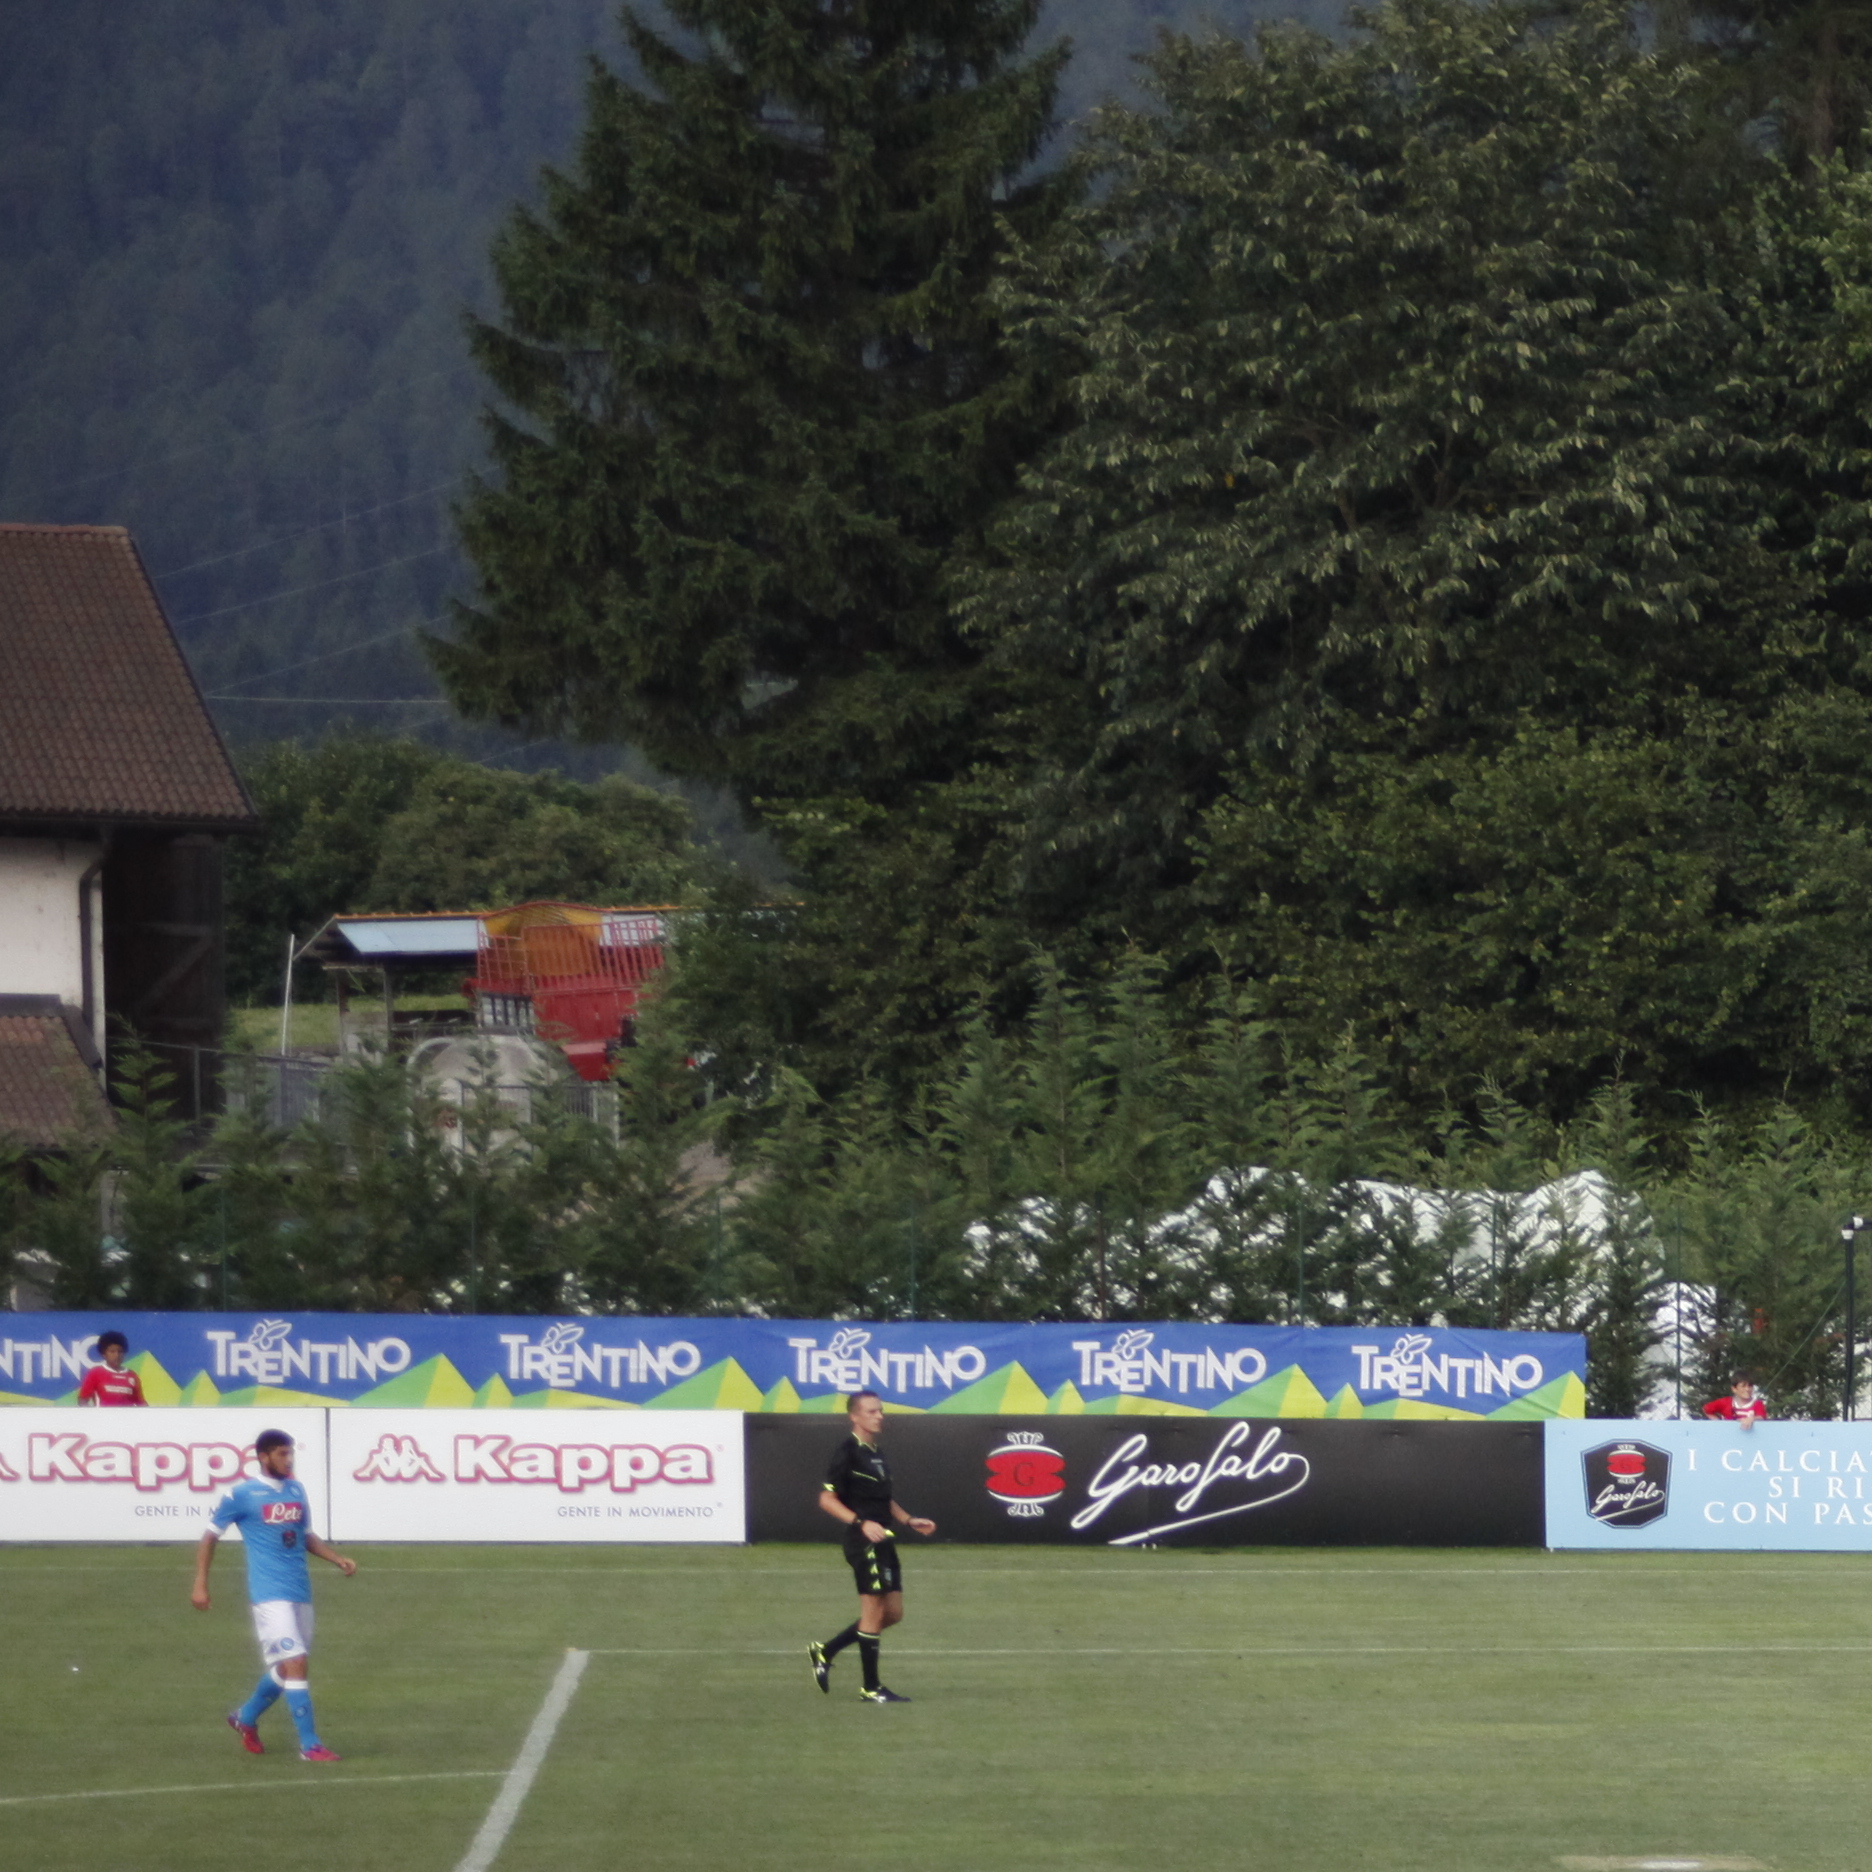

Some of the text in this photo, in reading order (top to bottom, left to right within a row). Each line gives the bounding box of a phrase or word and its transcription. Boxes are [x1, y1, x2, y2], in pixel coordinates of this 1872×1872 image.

[206, 1331, 411, 1385] TRENTINO
[500, 1334, 702, 1388] TRENTINO
[788, 1338, 987, 1393] TRENTINO
[1072, 1341, 1267, 1394] TRENTINO
[1351, 1345, 1544, 1398] TRENTINO
[454, 1433, 714, 1493] Kappa
[1071, 1421, 1310, 1545] Garofalo
[1688, 1449, 1697, 1472] I
[134, 1505, 180, 1517] GENTE
[186, 1505, 201, 1517] IN
[557, 1506, 714, 1518] GENTE IN MOVIMENTO
[1590, 1480, 1665, 1521] Garofalo
[1704, 1501, 1788, 1525] CON
[1768, 1476, 1800, 1499] SI
